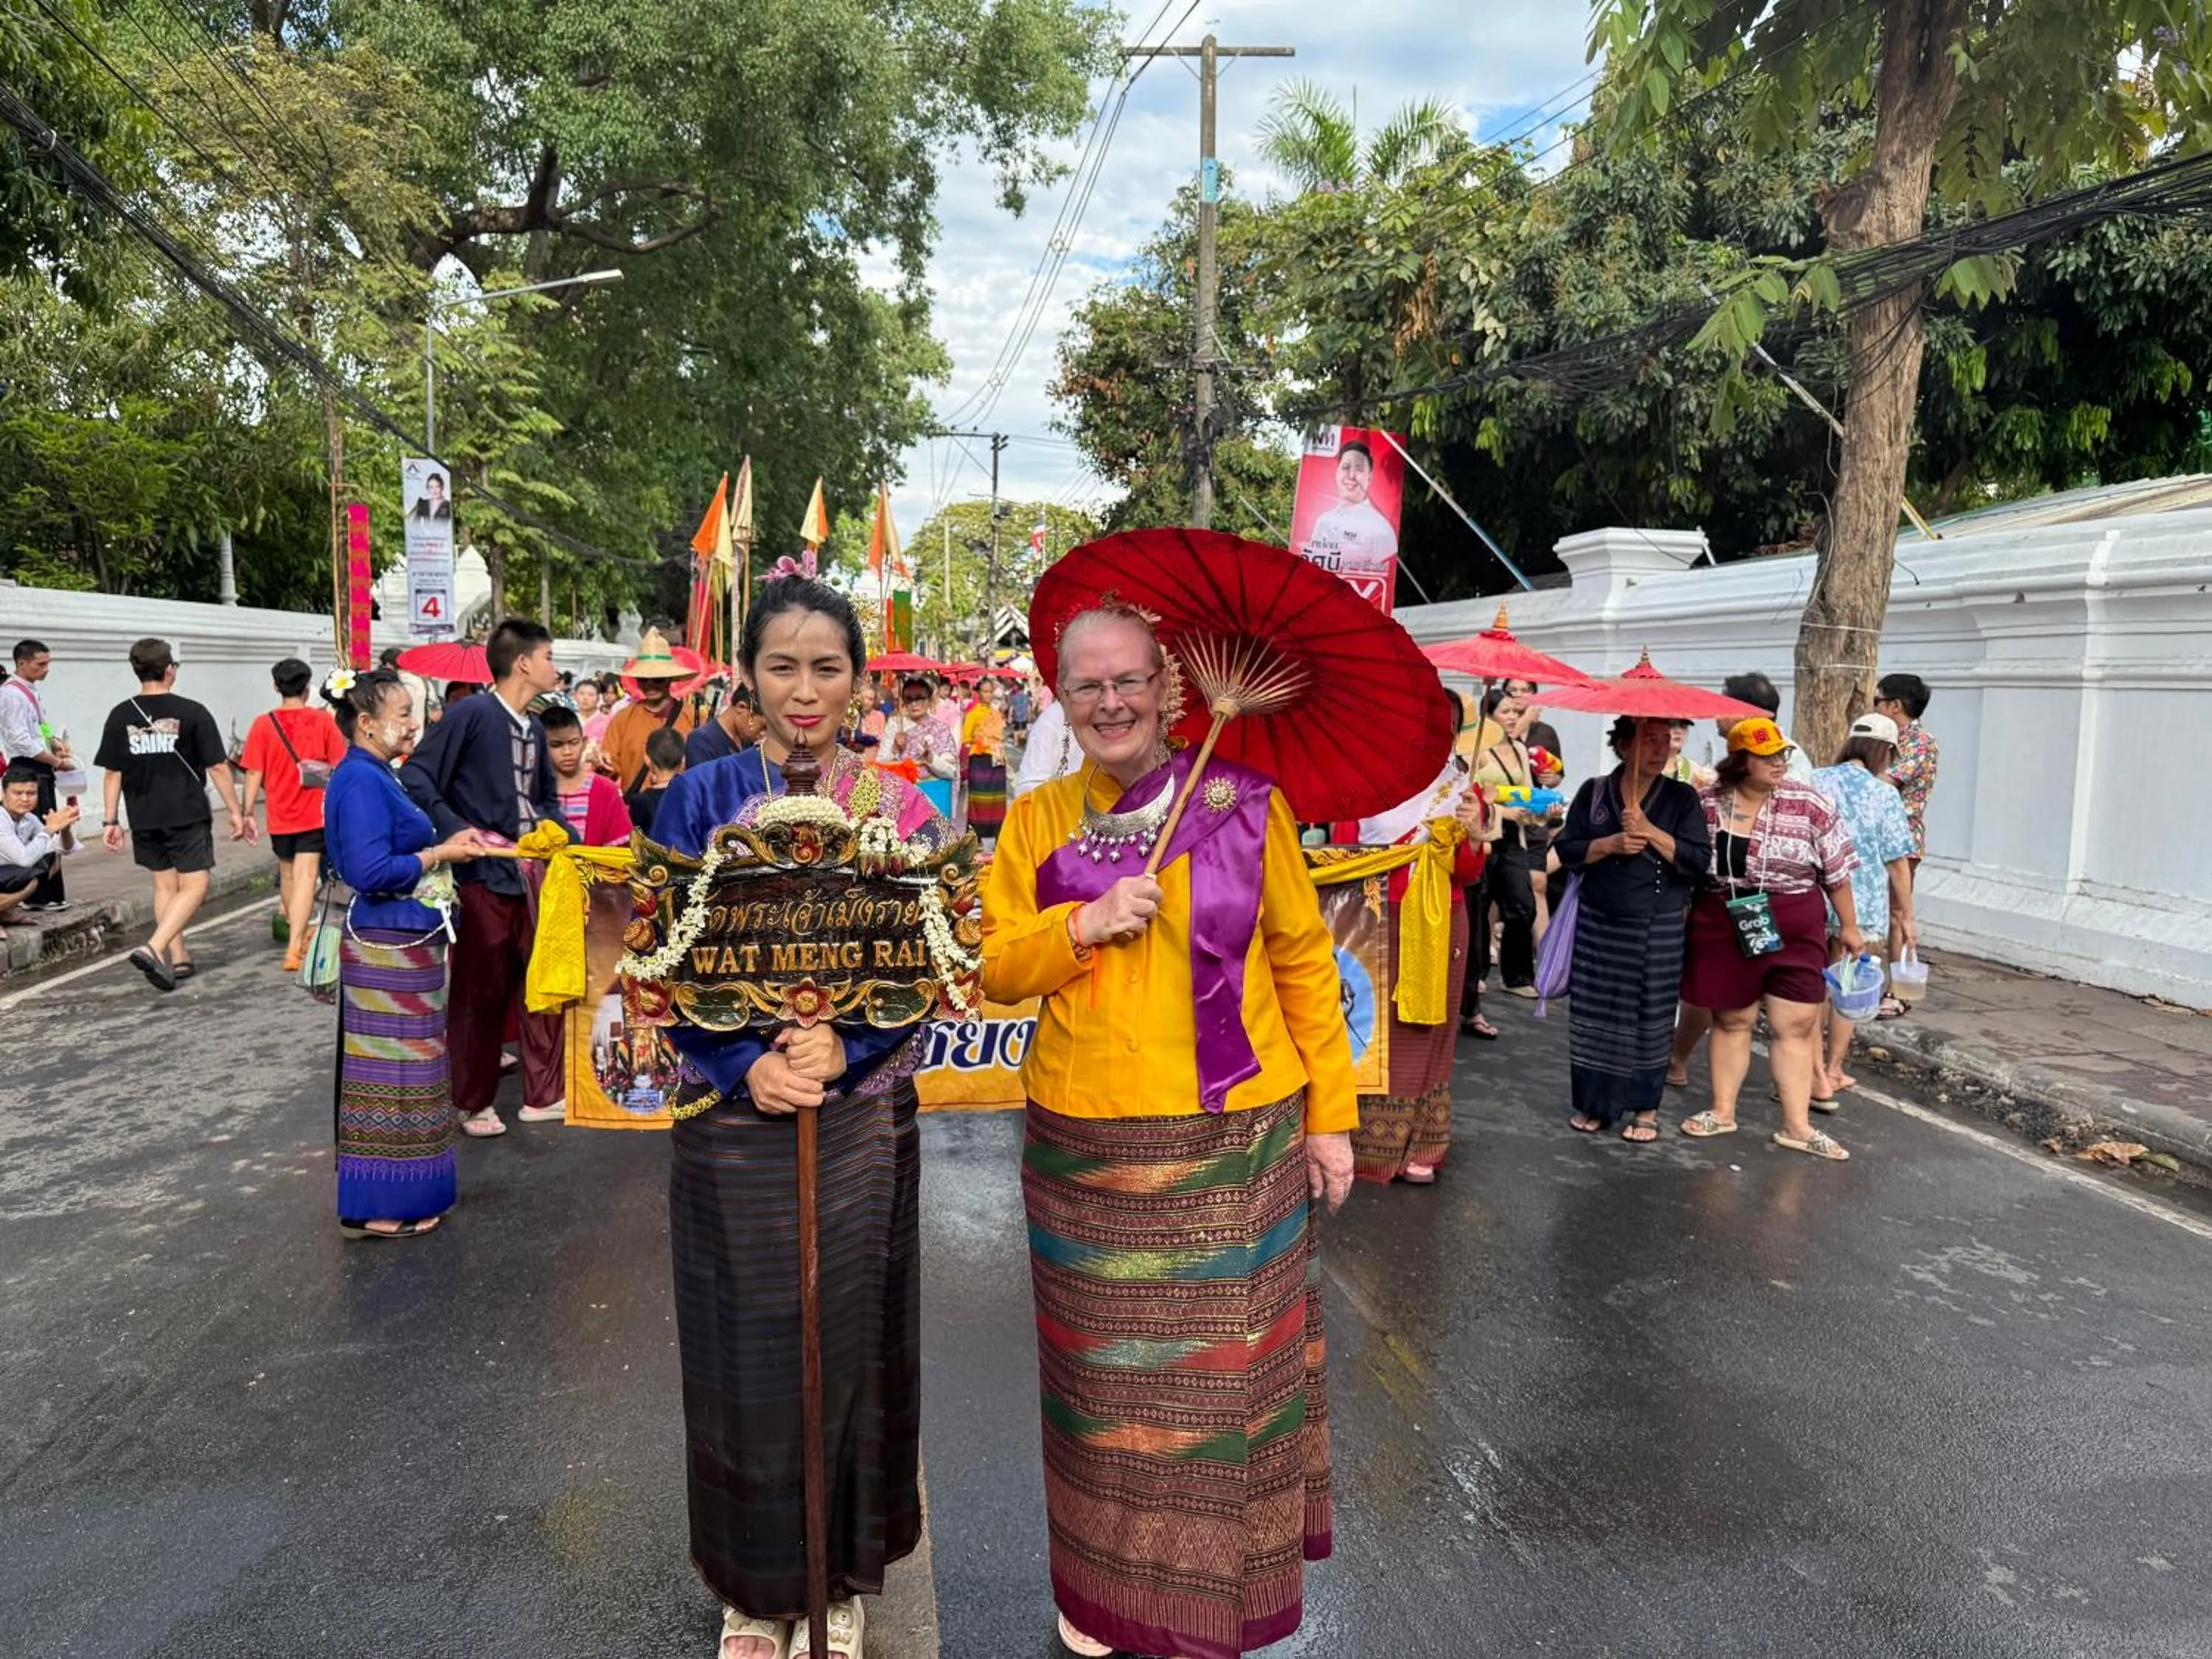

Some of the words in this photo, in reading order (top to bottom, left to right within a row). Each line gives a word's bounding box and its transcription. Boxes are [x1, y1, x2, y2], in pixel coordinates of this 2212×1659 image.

[422, 596, 442, 618] 4
[129, 731, 179, 754] SAINT
[1739, 915, 1770, 931] Grab
[690, 943, 760, 975] WAT
[771, 941, 863, 973] MENG
[872, 939, 927, 969] RAI
